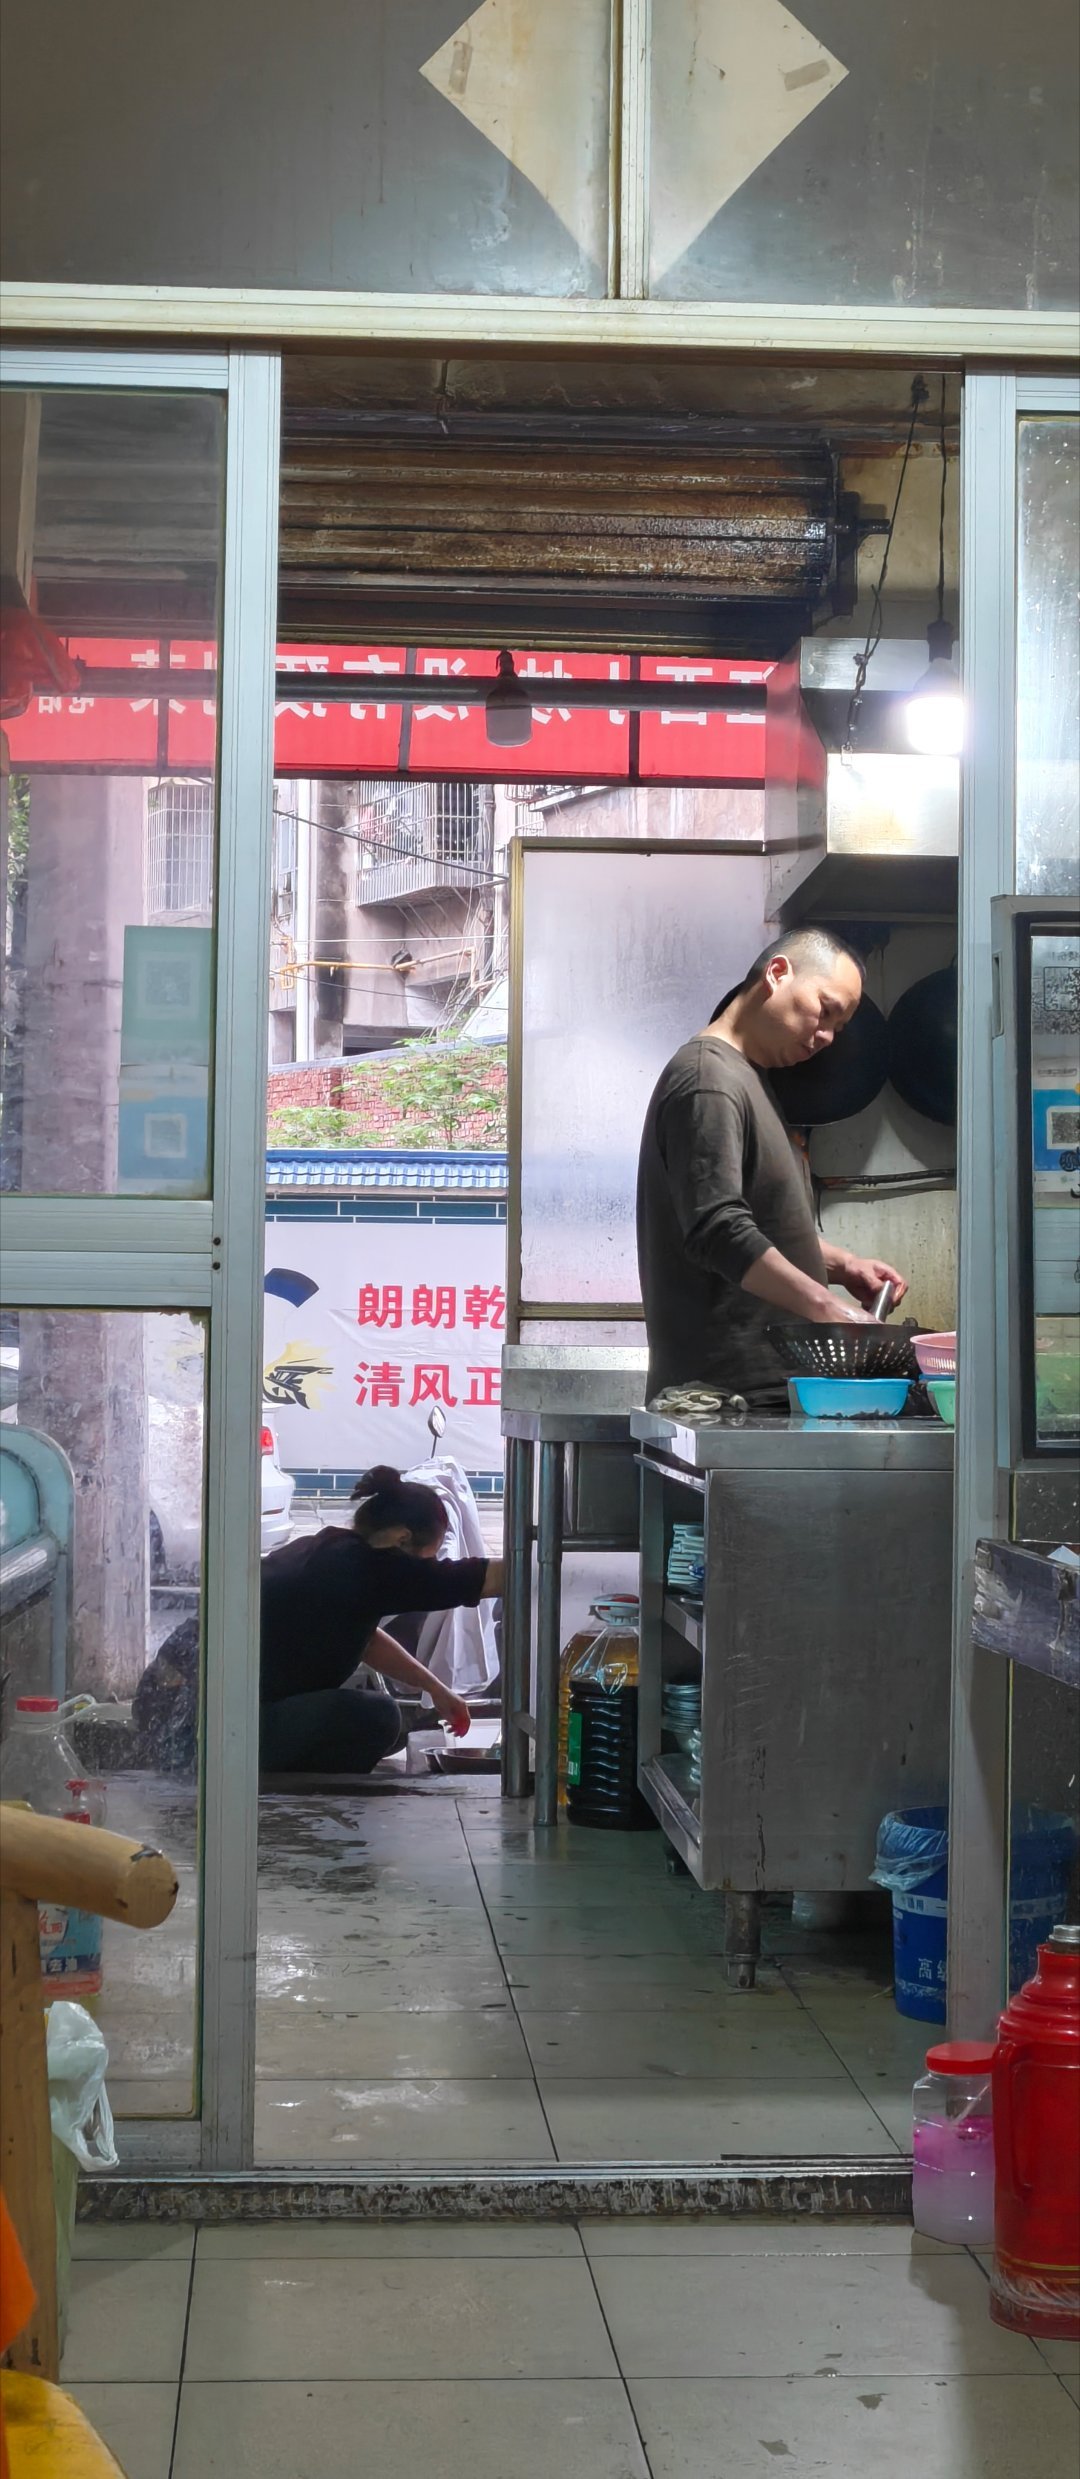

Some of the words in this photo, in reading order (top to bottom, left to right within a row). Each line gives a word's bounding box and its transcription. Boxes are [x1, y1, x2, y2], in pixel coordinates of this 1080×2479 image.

[357, 1283, 506, 1330] 朗朗乾
[353, 1361, 503, 1408] 清风正
